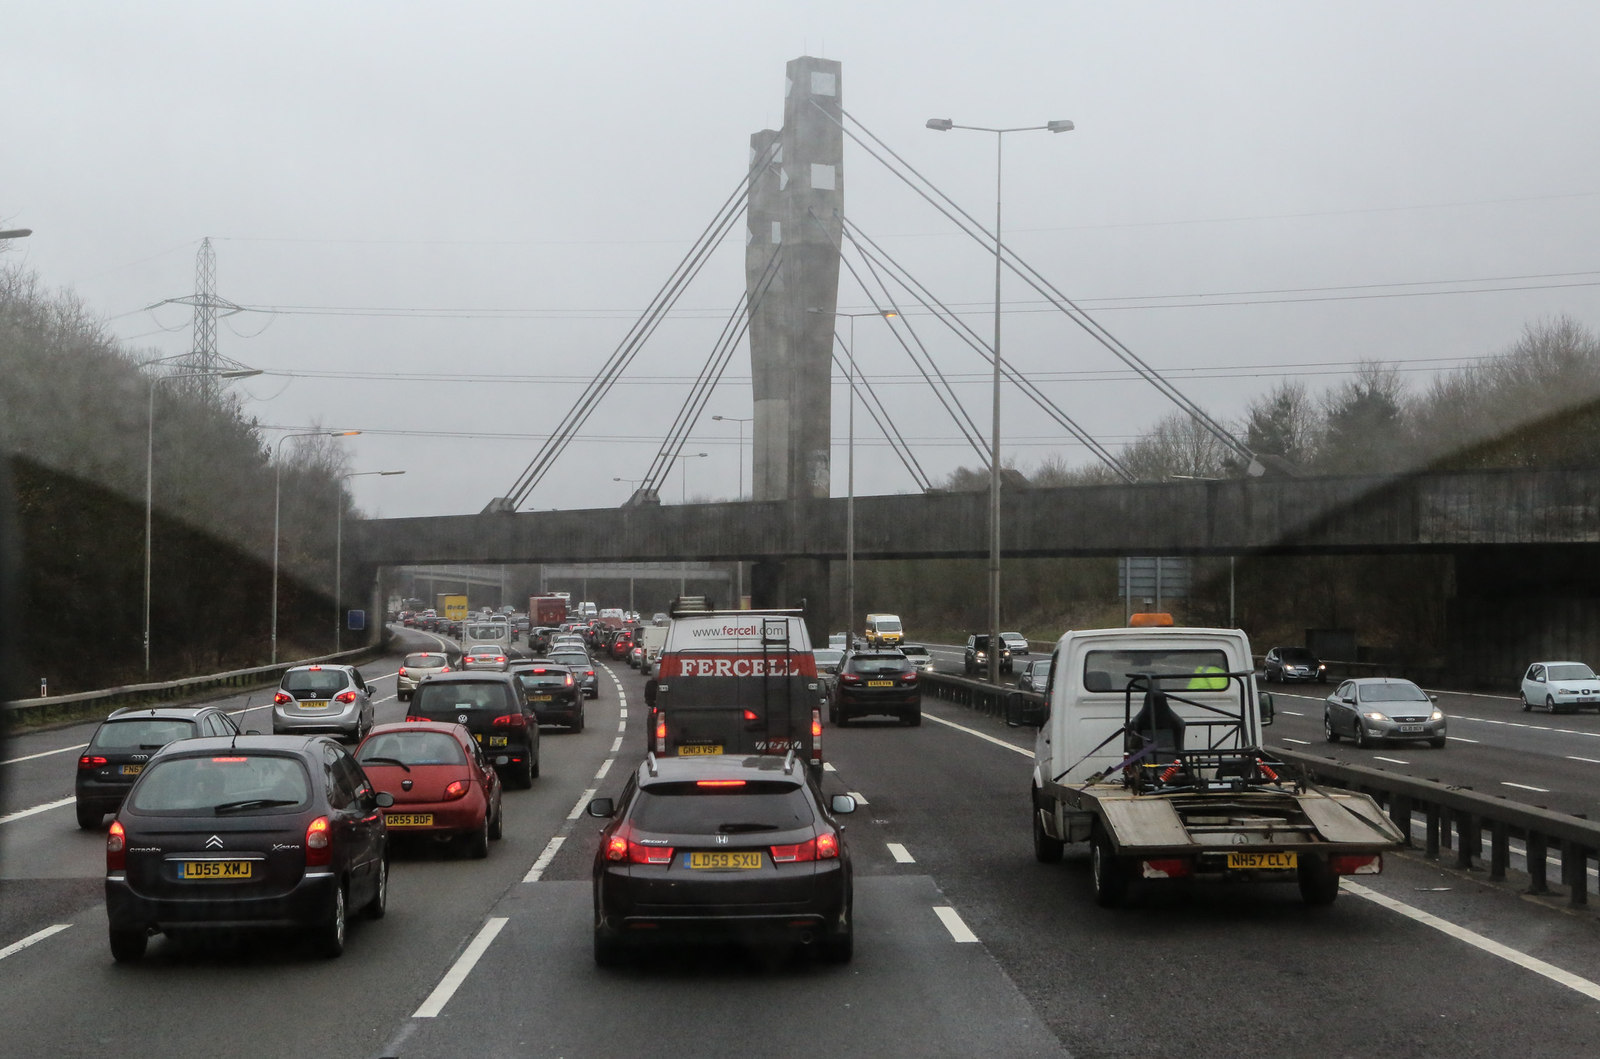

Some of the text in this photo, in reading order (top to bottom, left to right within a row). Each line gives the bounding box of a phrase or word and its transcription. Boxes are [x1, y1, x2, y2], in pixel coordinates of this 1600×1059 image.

[692, 625, 784, 638] www.fercell.com
[680, 659, 799, 677] FERCELL
[683, 745, 718, 754] GN13 VSF
[388, 815, 432, 825] GR55 BDF
[693, 853, 759, 867] LD59 SXU
[1232, 854, 1292, 866] NH57 CLY
[186, 862, 250, 876] LD55 XMJ
